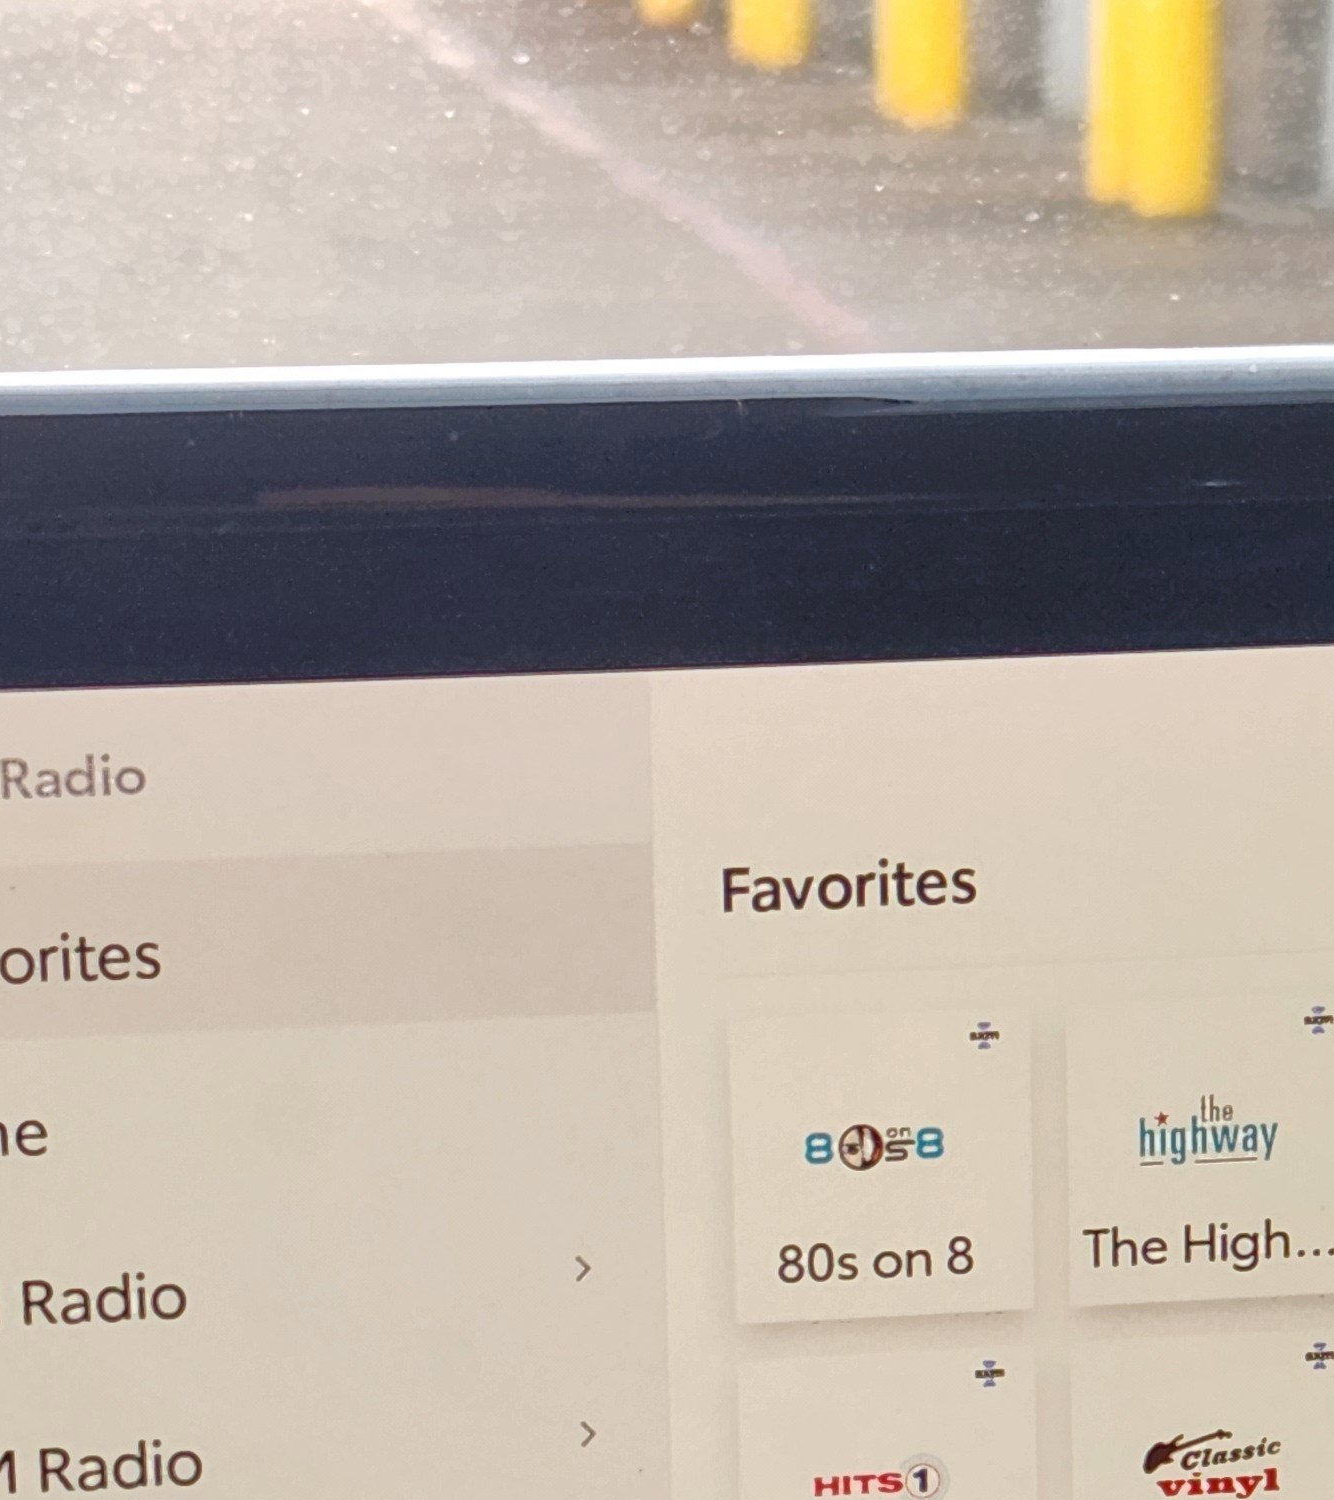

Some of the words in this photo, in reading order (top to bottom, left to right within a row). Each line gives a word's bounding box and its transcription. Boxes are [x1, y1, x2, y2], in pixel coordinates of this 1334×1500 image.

[0, 753, 147, 800] Radio
[717, 857, 977, 913] Favorites
[1200, 1094, 1234, 1122] the
[1139, 1114, 1279, 1166] highway
[777, 1242, 859, 1284] 80s
[872, 1249, 932, 1279] on
[947, 1235, 974, 1275] 8
[1082, 1225, 1168, 1268] The
[21, 1272, 187, 1326] Radio
[39, 1439, 203, 1493] Radio
[1180, 1437, 1282, 1470] Classic
[813, 1472, 904, 1497] HITS
[1156, 1467, 1280, 1499] vinyl
